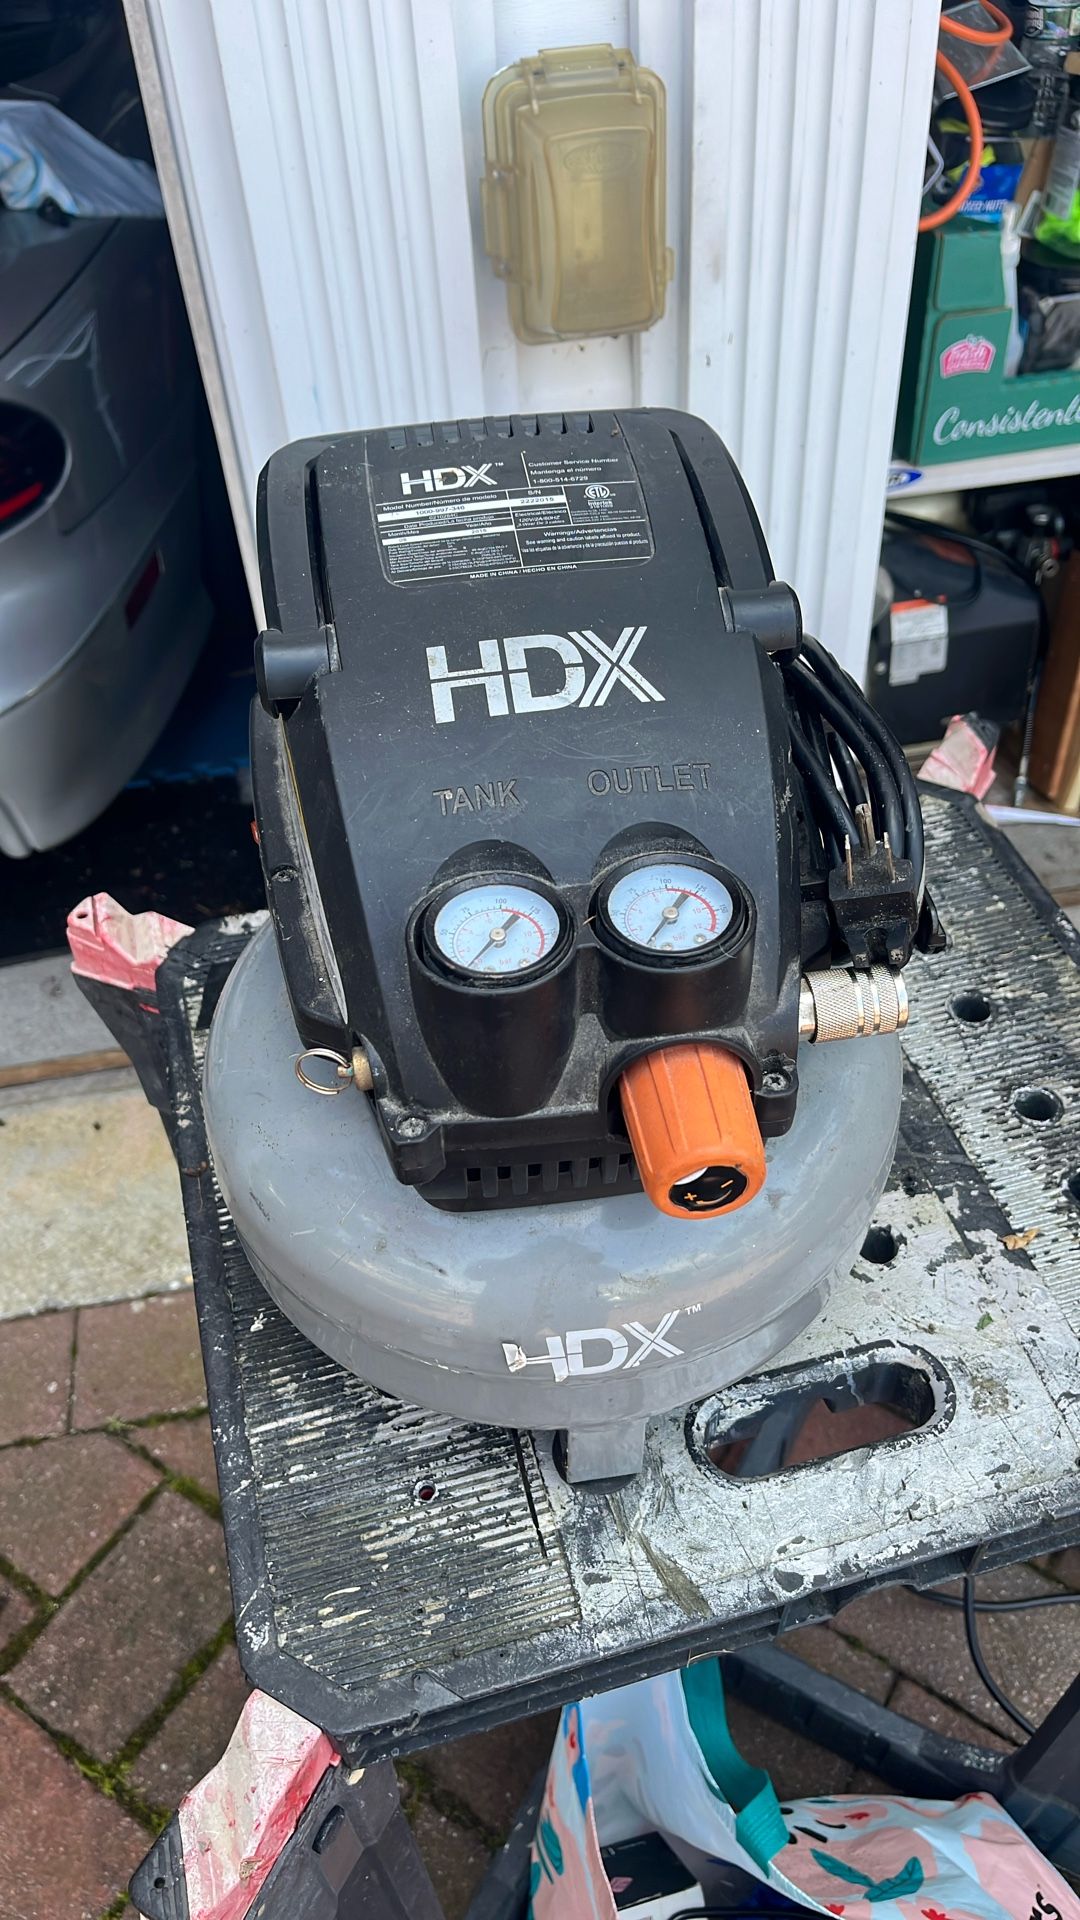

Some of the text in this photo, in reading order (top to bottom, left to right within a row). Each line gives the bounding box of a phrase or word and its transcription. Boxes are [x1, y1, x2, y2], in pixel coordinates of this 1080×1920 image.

[933, 395, 1080, 445] Consistentl
[528, 460, 562, 468] Customer
[530, 468, 565, 476] Mantenga
[400, 463, 498, 495] HDX
[532, 476, 588, 484] 1-800-514-6729
[383, 504, 404, 512] Model
[544, 527, 618, 537] Warnings/Advertencias
[538, 538, 556, 546] warning
[426, 626, 667, 724] HDX
[587, 763, 711, 796] OUTLET
[432, 779, 522, 816] TANK
[695, 883, 706, 892] 125
[530, 906, 541, 914] 125
[502, 1309, 685, 1382] HDX
